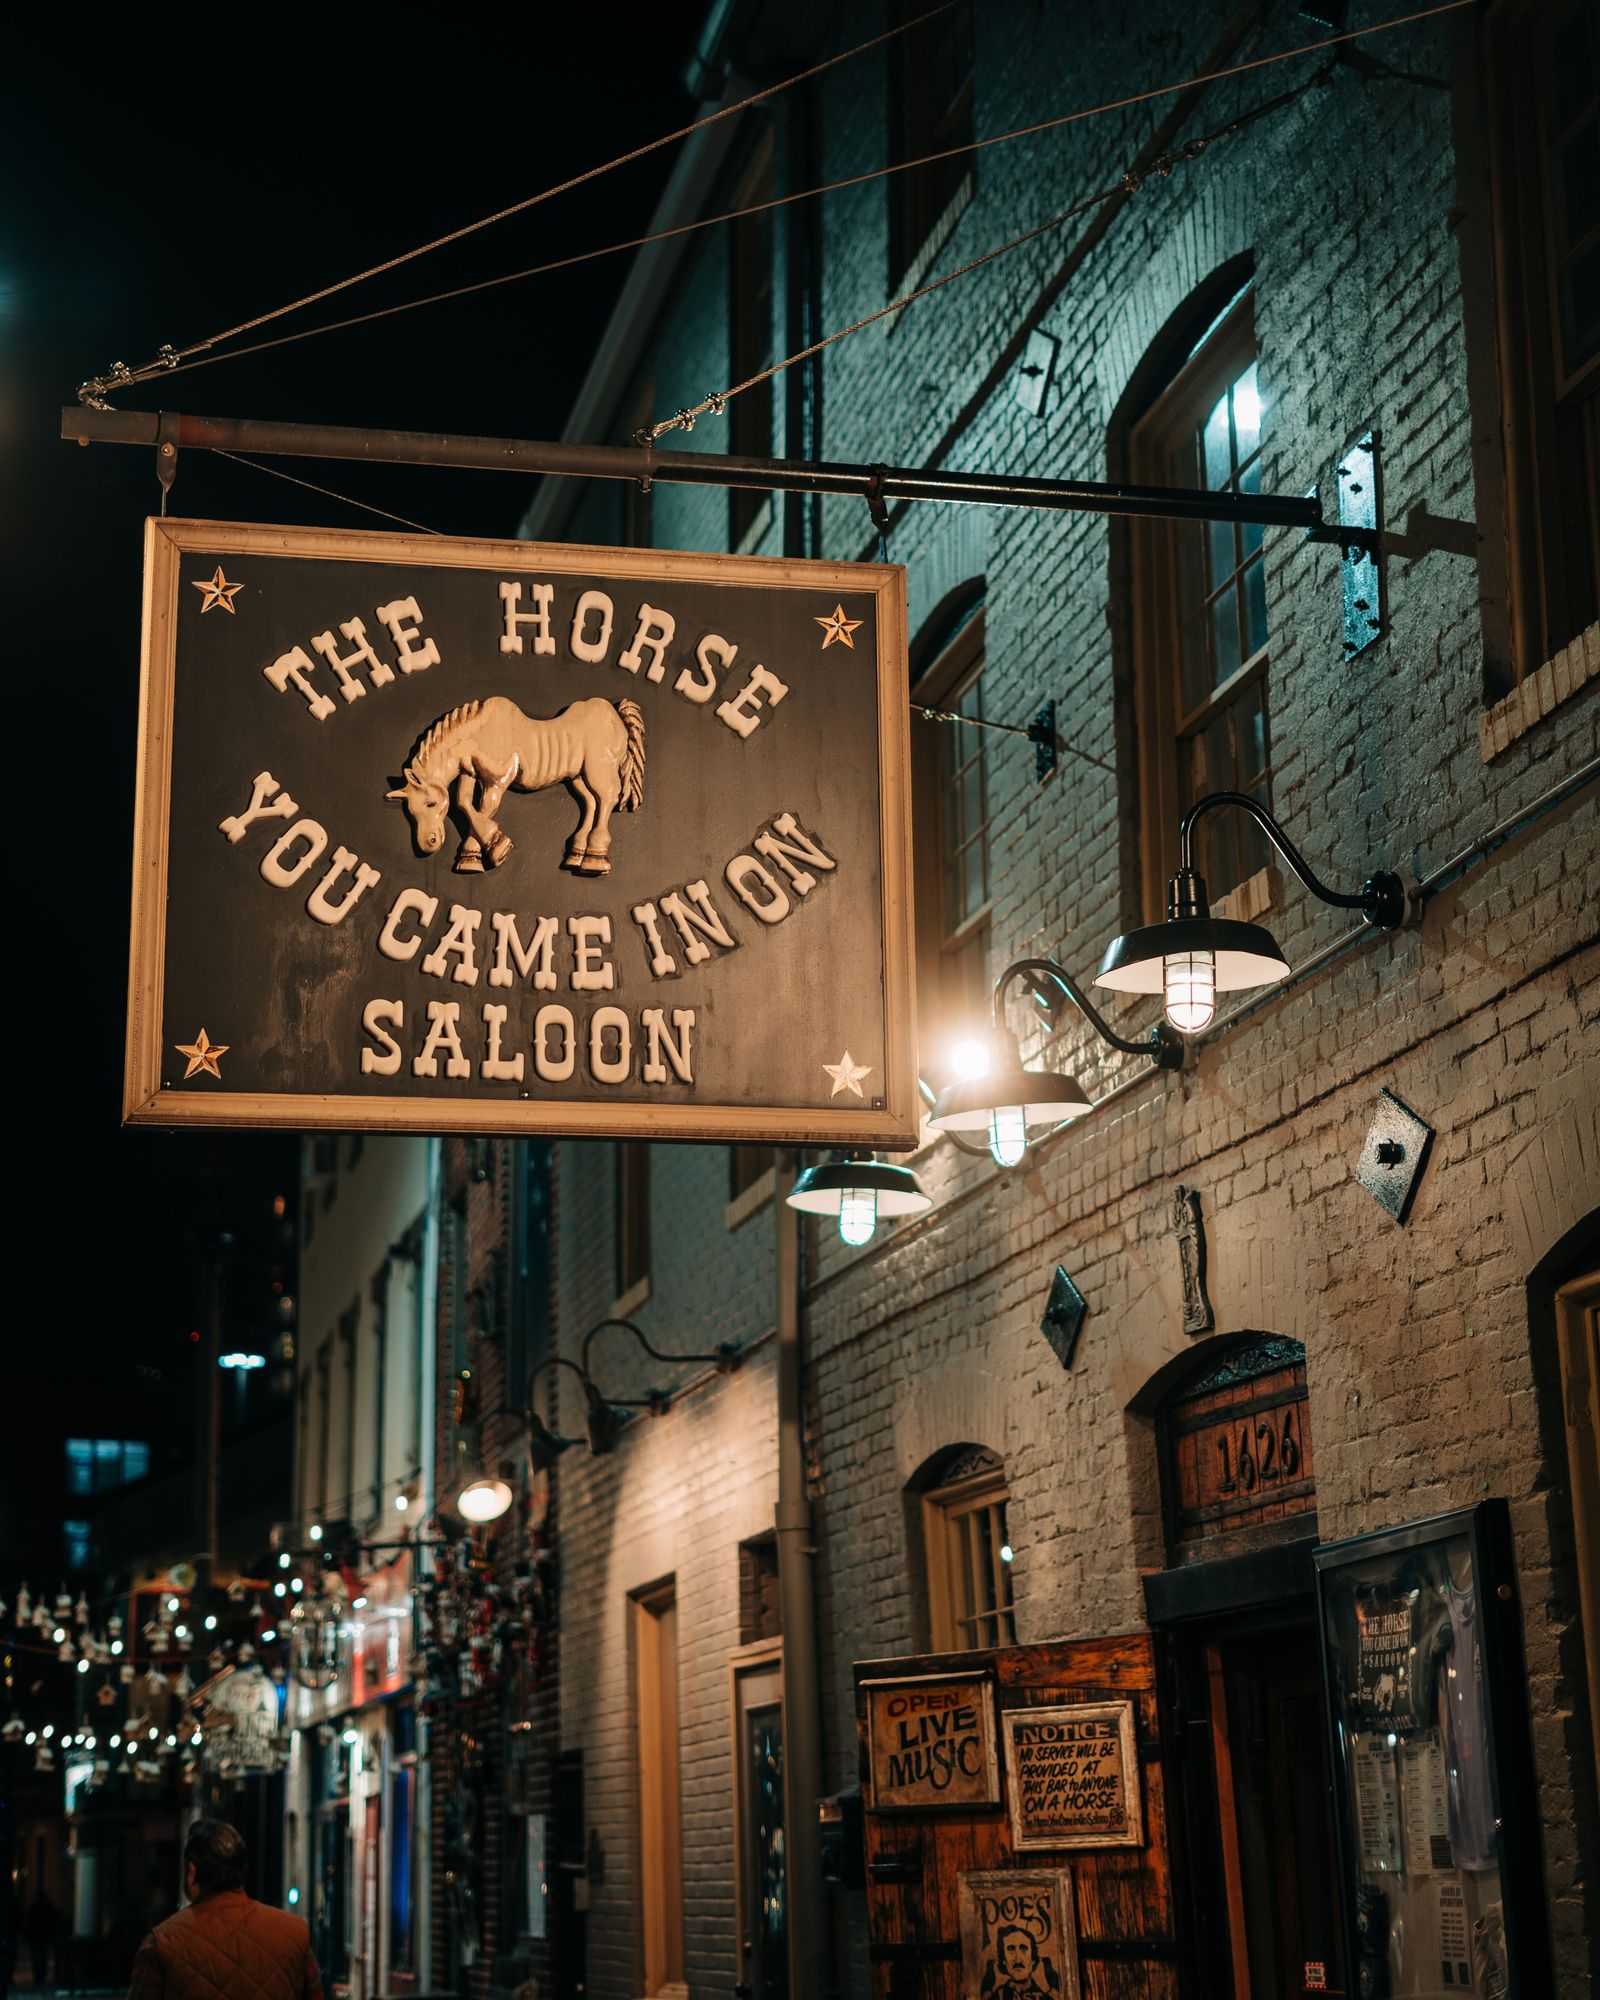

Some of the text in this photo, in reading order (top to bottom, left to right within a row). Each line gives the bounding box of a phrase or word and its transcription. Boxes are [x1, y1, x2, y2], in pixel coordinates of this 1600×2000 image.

[263, 581, 789, 739] THE HORSE
[218, 771, 836, 991] YOU CAME IN ON
[361, 999, 694, 1085] SALOON
[1217, 1412, 1300, 1492] 1626
[1381, 1610, 1409, 1634] HORSE
[1368, 1651, 1402, 1668] SALOON
[887, 1692, 960, 1718] OPEN
[898, 1705, 977, 1750] LIVE
[1022, 1722, 1110, 1744] NOTICE
[888, 1736, 982, 1790] MUSIC
[1020, 1742, 1116, 1763] NO SERVICE WILL BE
[1020, 1760, 1102, 1779] PROVIDED AT
[1023, 1779, 1045, 1796] THIS
[1046, 1779, 1068, 1794] BAR
[1079, 1775, 1119, 1792] ANYONE
[1025, 1791, 1120, 1813] ON A HORSE.
[981, 1895, 1051, 1950] POE'S
